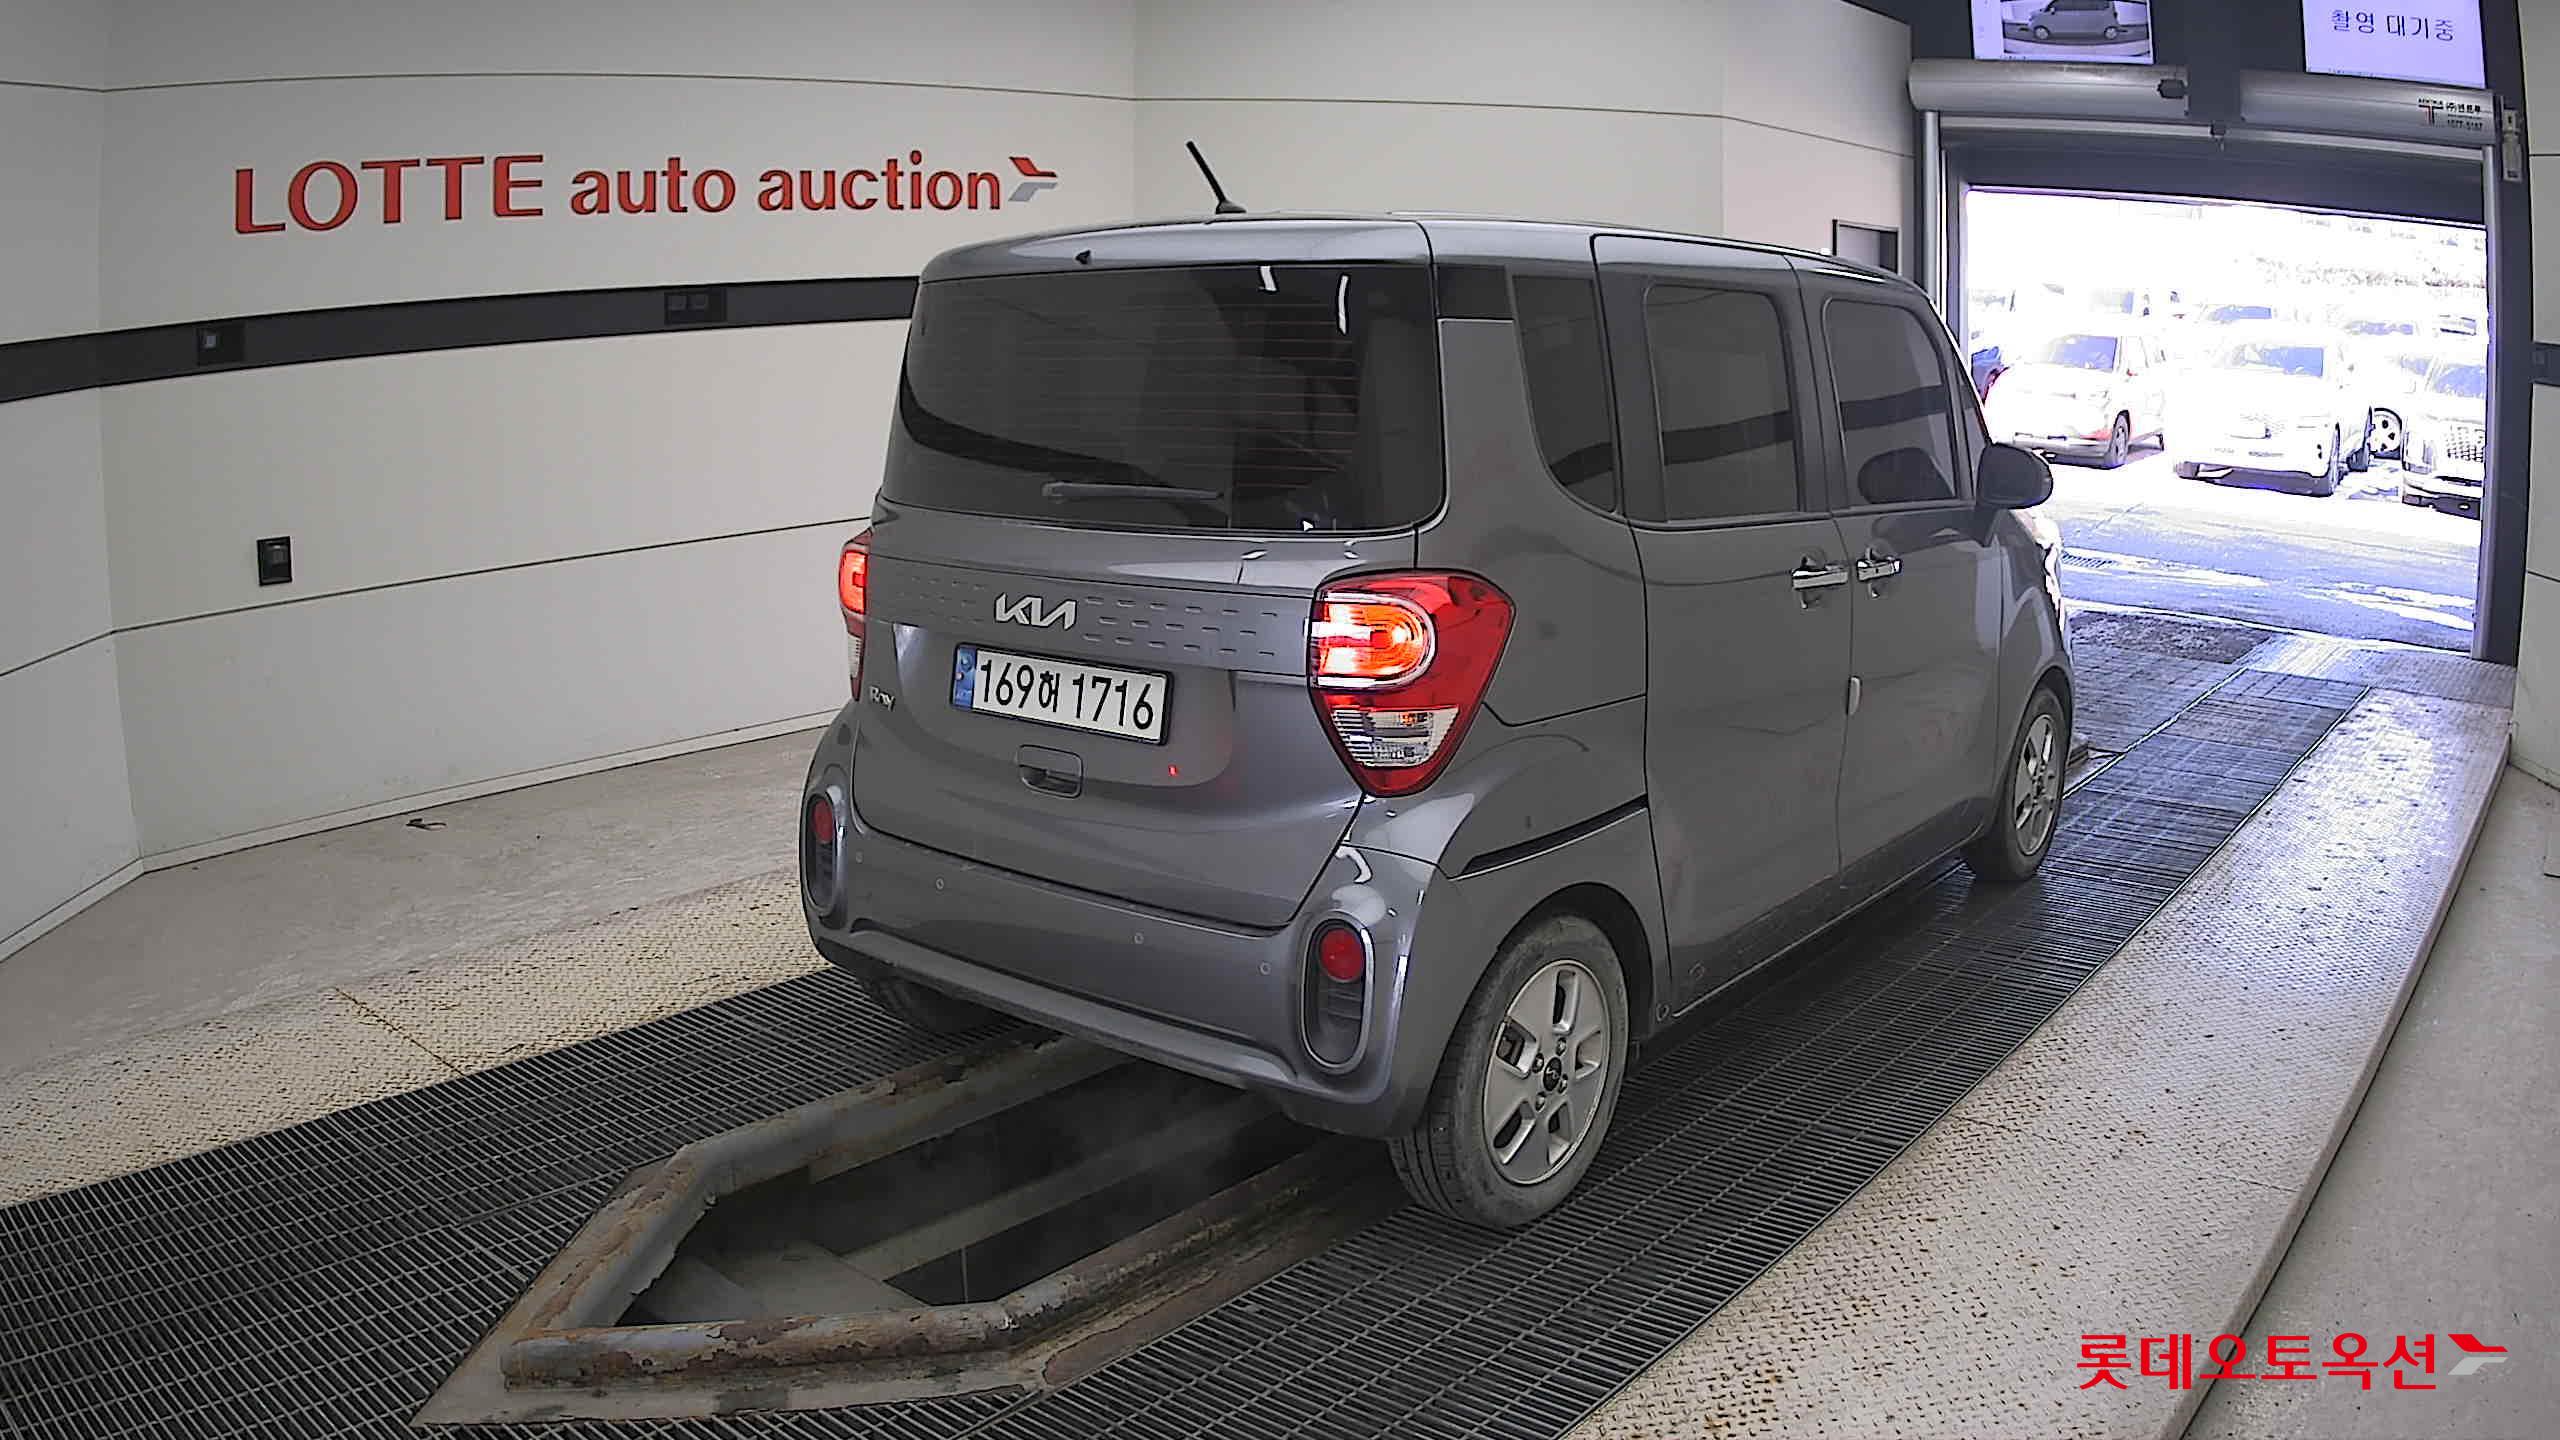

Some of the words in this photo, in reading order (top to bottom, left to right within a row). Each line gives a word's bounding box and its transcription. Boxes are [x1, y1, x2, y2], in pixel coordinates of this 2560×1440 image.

[2331, 9, 2375, 34] 촬영
[2386, 15, 2454, 41] 대기중
[235, 154, 544, 234] LOTTE
[571, 156, 737, 215] auto
[758, 150, 1000, 211] auction
[994, 592, 1078, 630] KIA
[980, 658, 1061, 713] 169허
[1072, 672, 1154, 730] 1716
